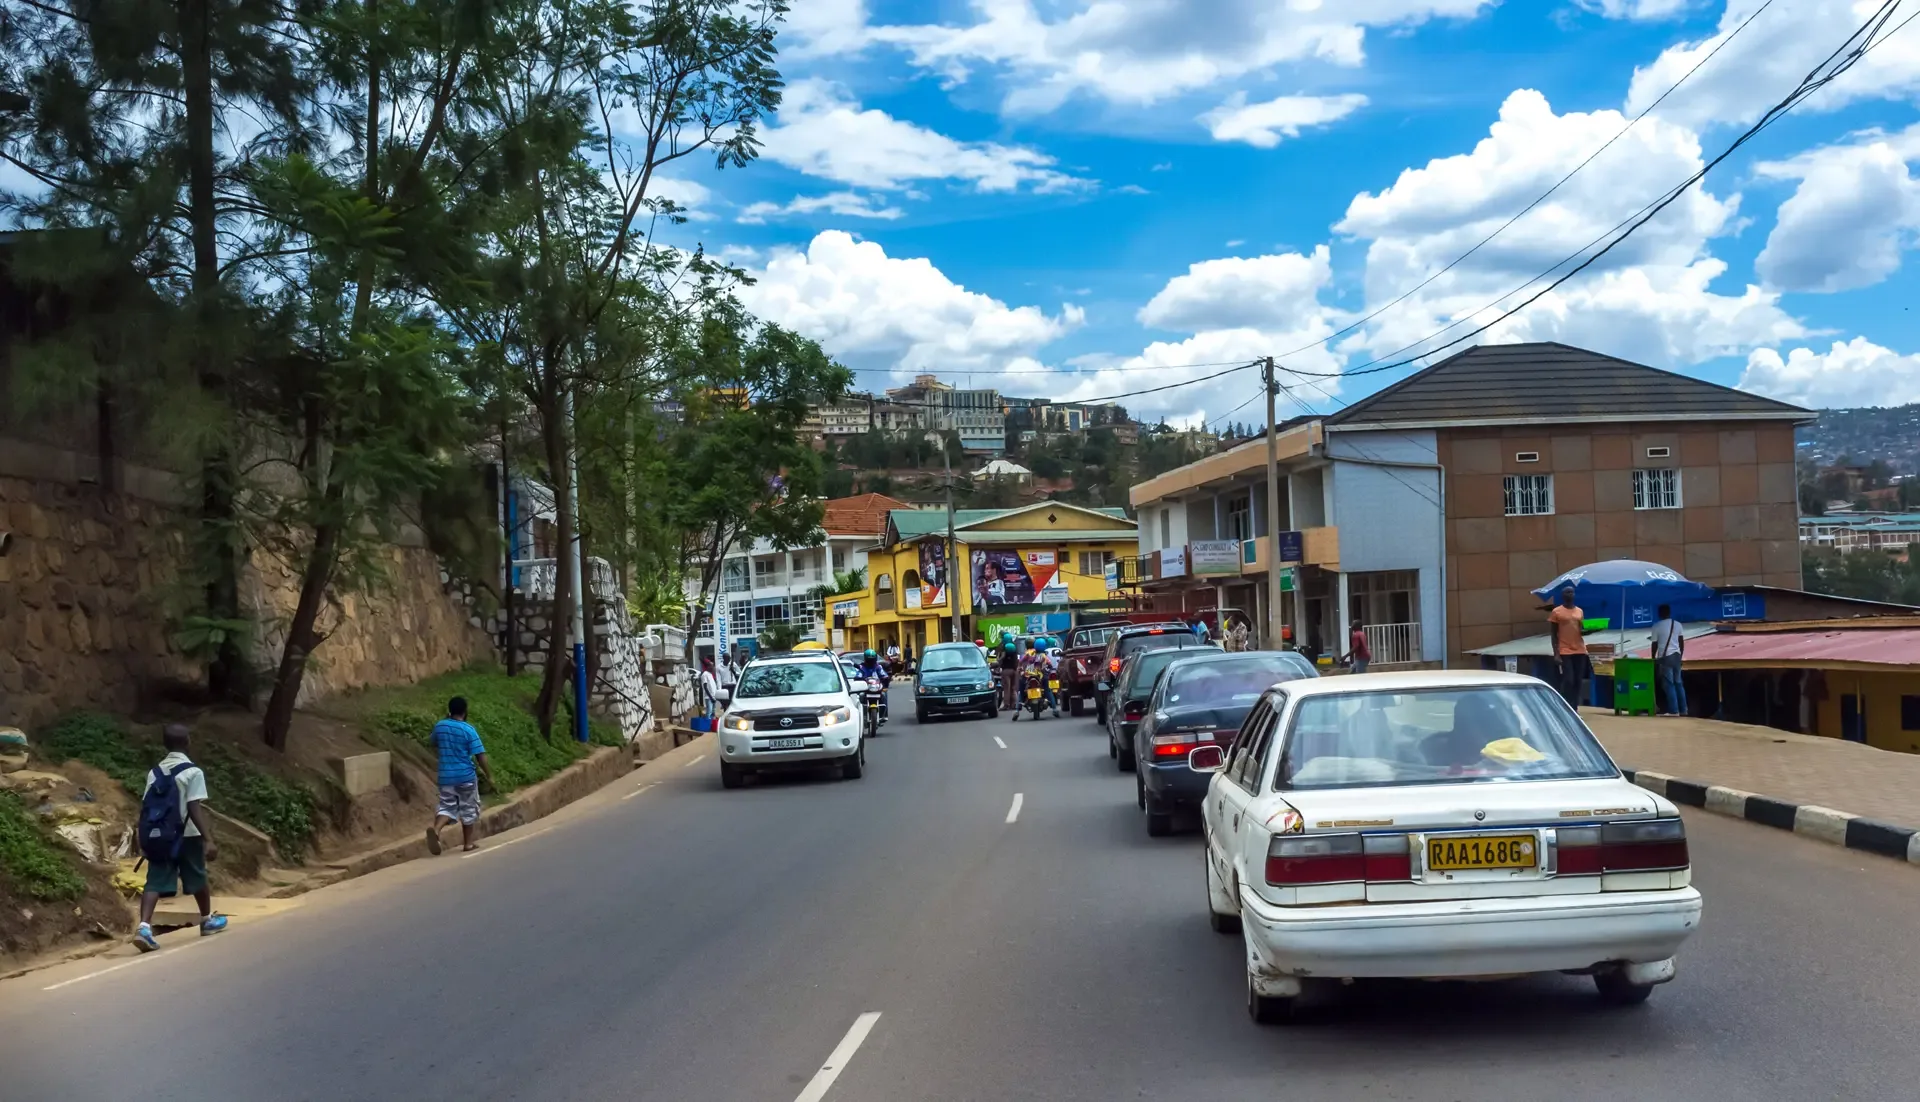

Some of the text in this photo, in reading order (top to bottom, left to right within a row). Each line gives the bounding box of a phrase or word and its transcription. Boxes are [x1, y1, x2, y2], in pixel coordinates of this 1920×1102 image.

[1645, 570, 1678, 581] tigo
[786, 739, 797, 747] 355
[1432, 841, 1521, 866] RAA168G
